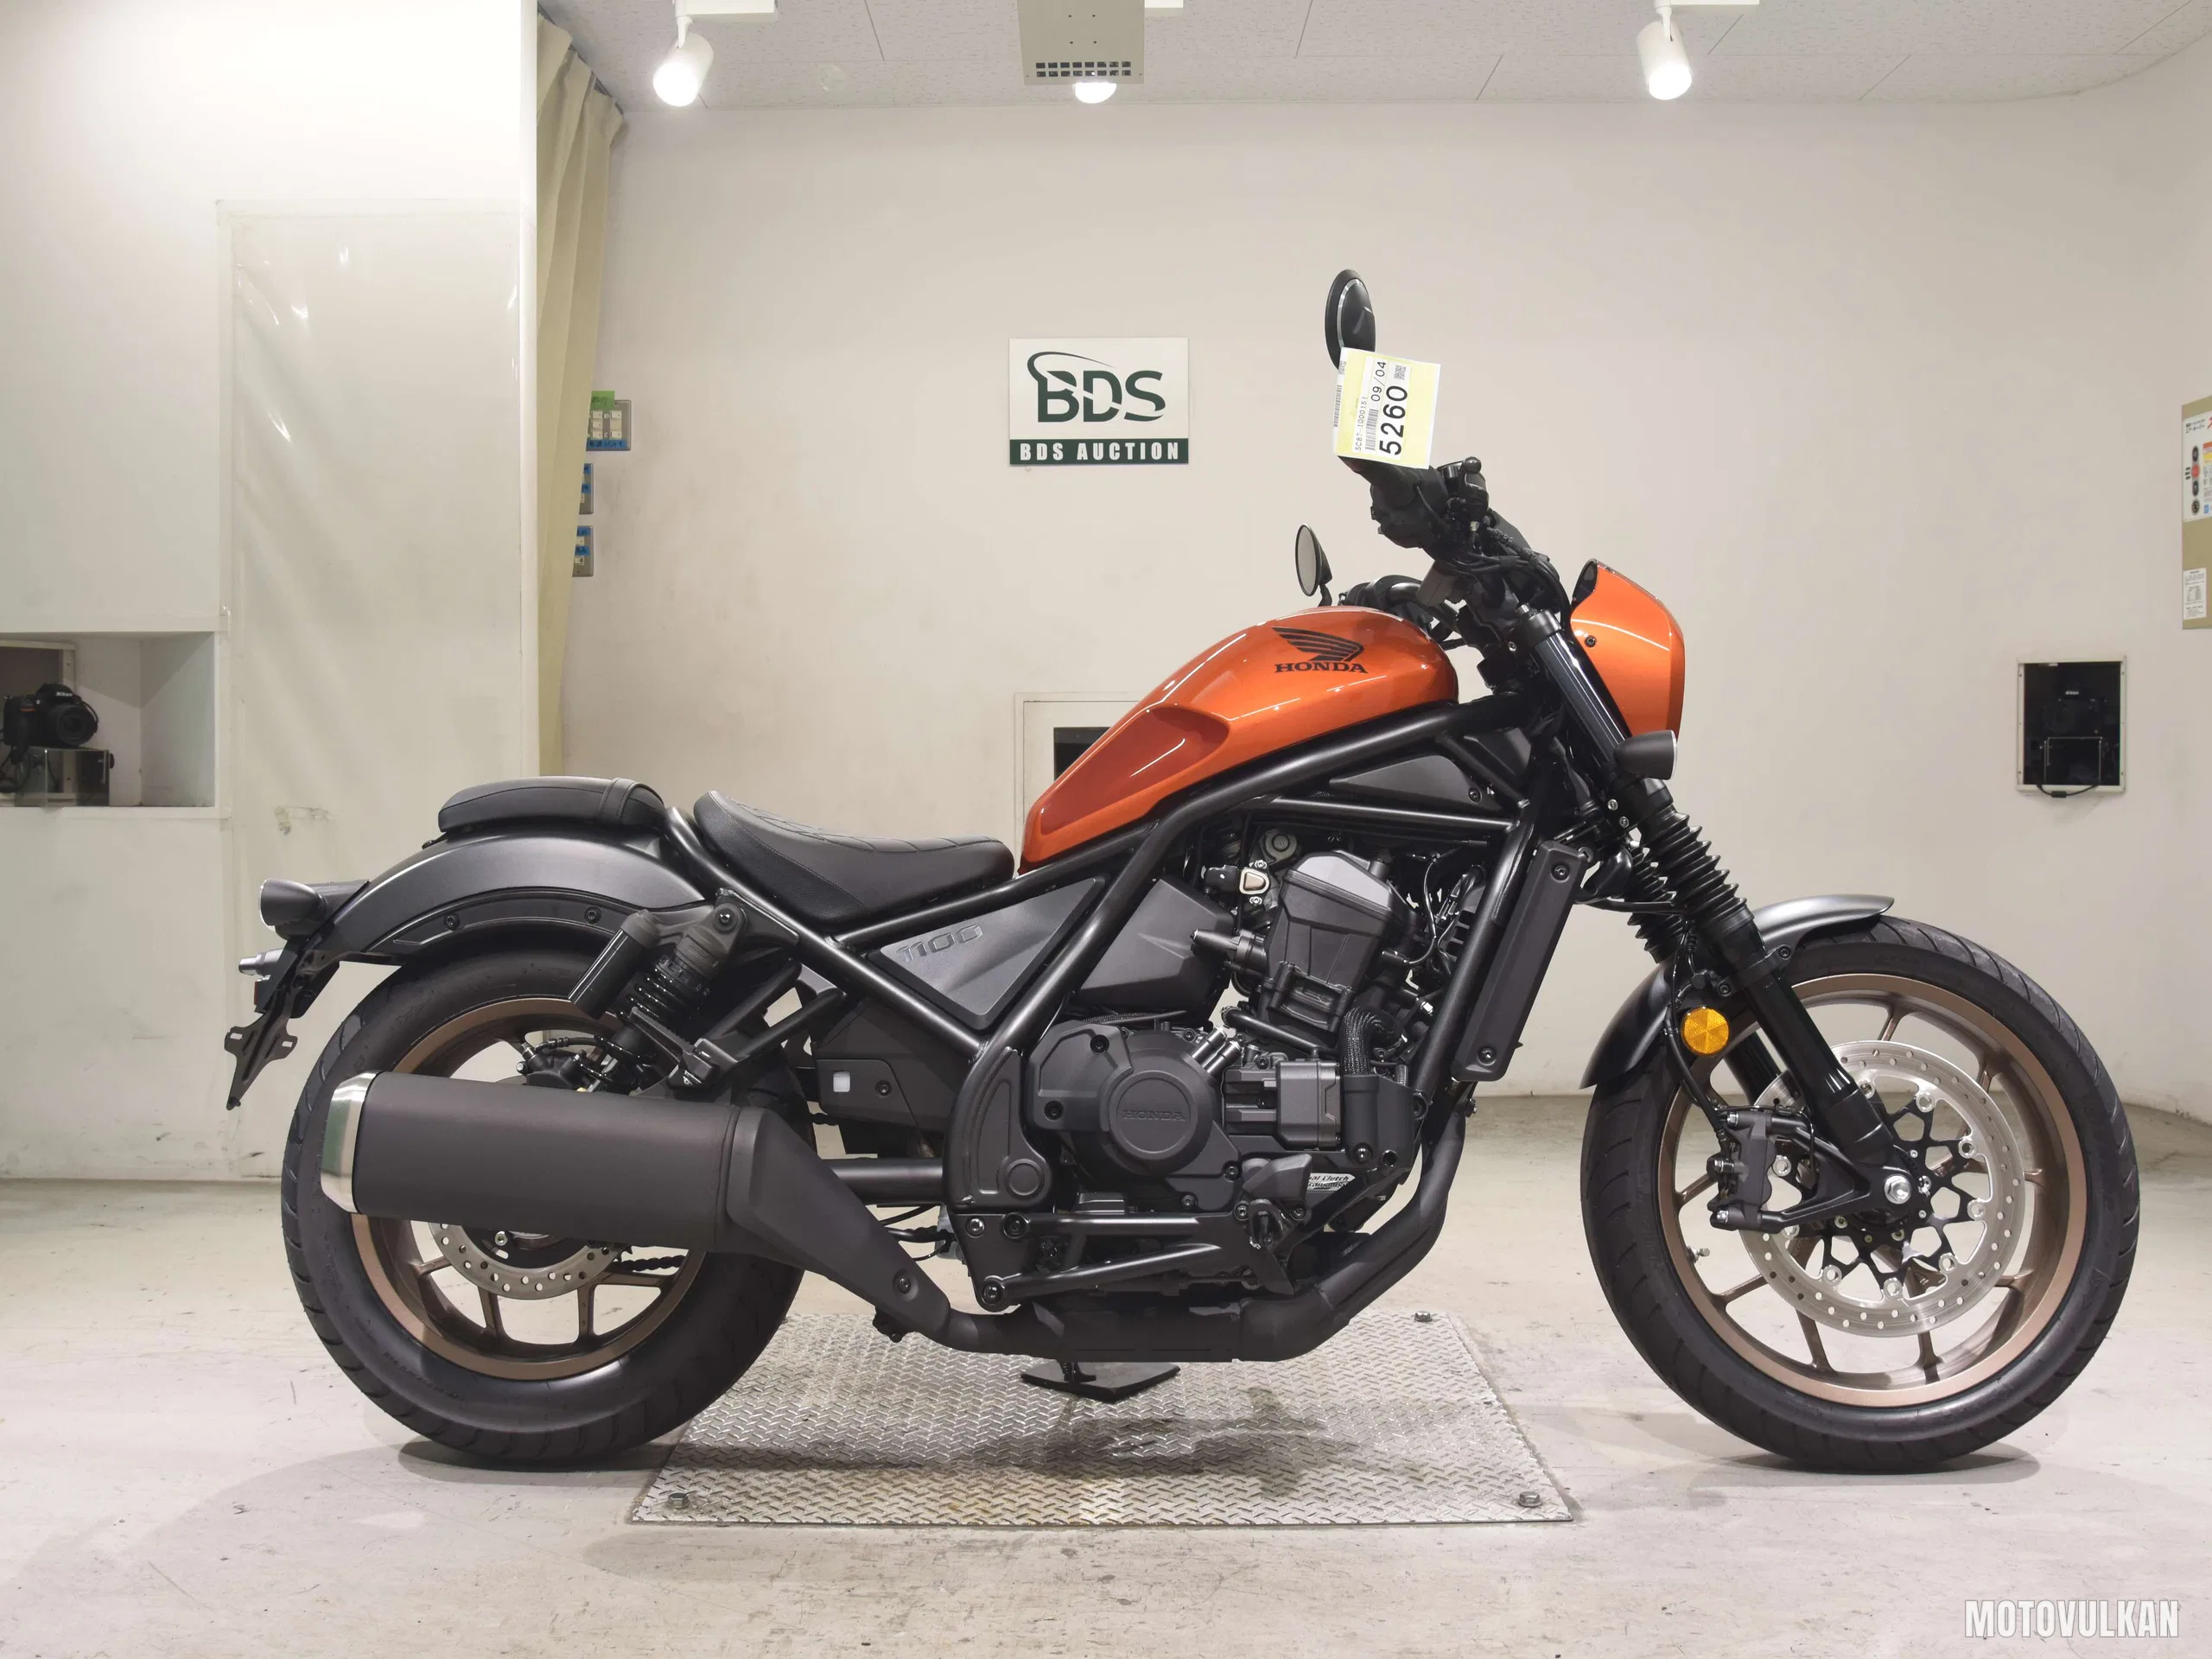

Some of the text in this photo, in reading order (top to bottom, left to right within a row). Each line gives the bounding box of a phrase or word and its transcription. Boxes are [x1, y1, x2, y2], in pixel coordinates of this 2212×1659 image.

[1027, 352, 1166, 423] BDS
[1370, 361, 1387, 402] 09/04
[1355, 397, 1368, 451] SC87-1000151
[1379, 385, 1408, 455] 5260
[1020, 442, 1179, 461] BDS AUCTION
[1274, 662, 1369, 674] HONDA
[896, 923, 983, 963] 1100
[1122, 1109, 1185, 1122] HONDA
